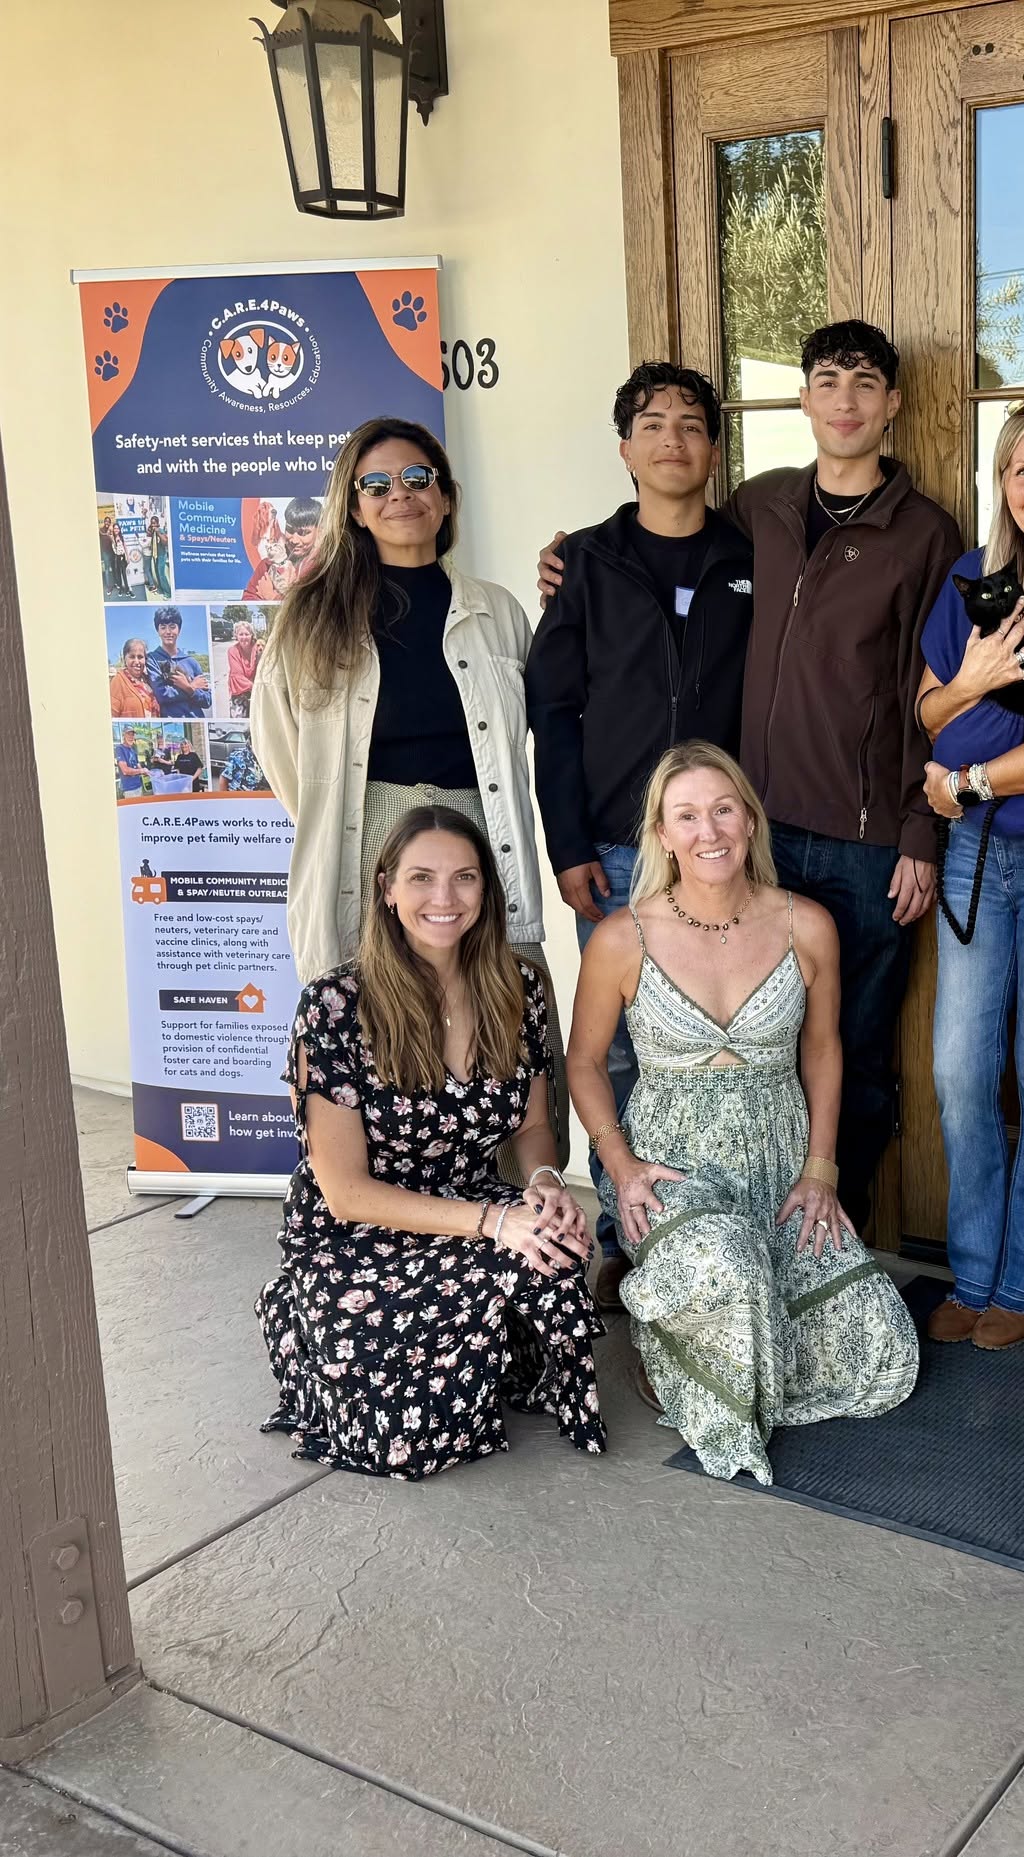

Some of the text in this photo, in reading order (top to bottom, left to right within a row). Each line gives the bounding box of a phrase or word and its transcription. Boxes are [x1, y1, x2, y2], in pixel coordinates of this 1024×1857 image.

[211, 299, 305, 330] C.A.R.E.4Paws
[200, 335, 321, 413] Community Awareness, Resources, Education
[115, 433, 188, 452] Safety-net
[192, 432, 250, 447] services
[252, 430, 283, 446] that
[287, 430, 324, 449] keep
[136, 455, 336, 476] and with the people who lo
[178, 500, 215, 511] Mobile
[178, 512, 237, 526] Community
[179, 523, 226, 535] Medicine
[142, 817, 220, 828] C.A.R.E.4Paws
[222, 817, 254, 828] works
[257, 818, 268, 828] to
[141, 833, 184, 845] improve
[187, 834, 206, 845] pet
[208, 833, 240, 845] family
[243, 833, 282, 844] welfare
[170, 877, 204, 885] MOBILE
[205, 877, 257, 886] COMMUNITY
[186, 889, 246, 897] SPAY/NEUTER
[154, 914, 263, 925] Free and low-cost spays/
[155, 926, 279, 936] neuters, veterinary care and
[155, 938, 269, 949] vaccine clinics, along with
[156, 950, 291, 961] assistance with veterinary care
[157, 962, 277, 973] through pet clinic partners.
[173, 996, 228, 1004] SAFE HAVEN
[161, 1020, 288, 1032] Support for families exposed
[161, 1033, 290, 1045] to domestic violence through
[162, 1044, 269, 1055] provision of confidential
[163, 1056, 190, 1065] foster
[213, 1056, 230, 1065] and
[232, 1057, 272, 1068] boarding
[164, 1067, 244, 1079] for cats and dogs.
[228, 1110, 295, 1123] Learn about
[229, 1125, 296, 1140] how get inv
